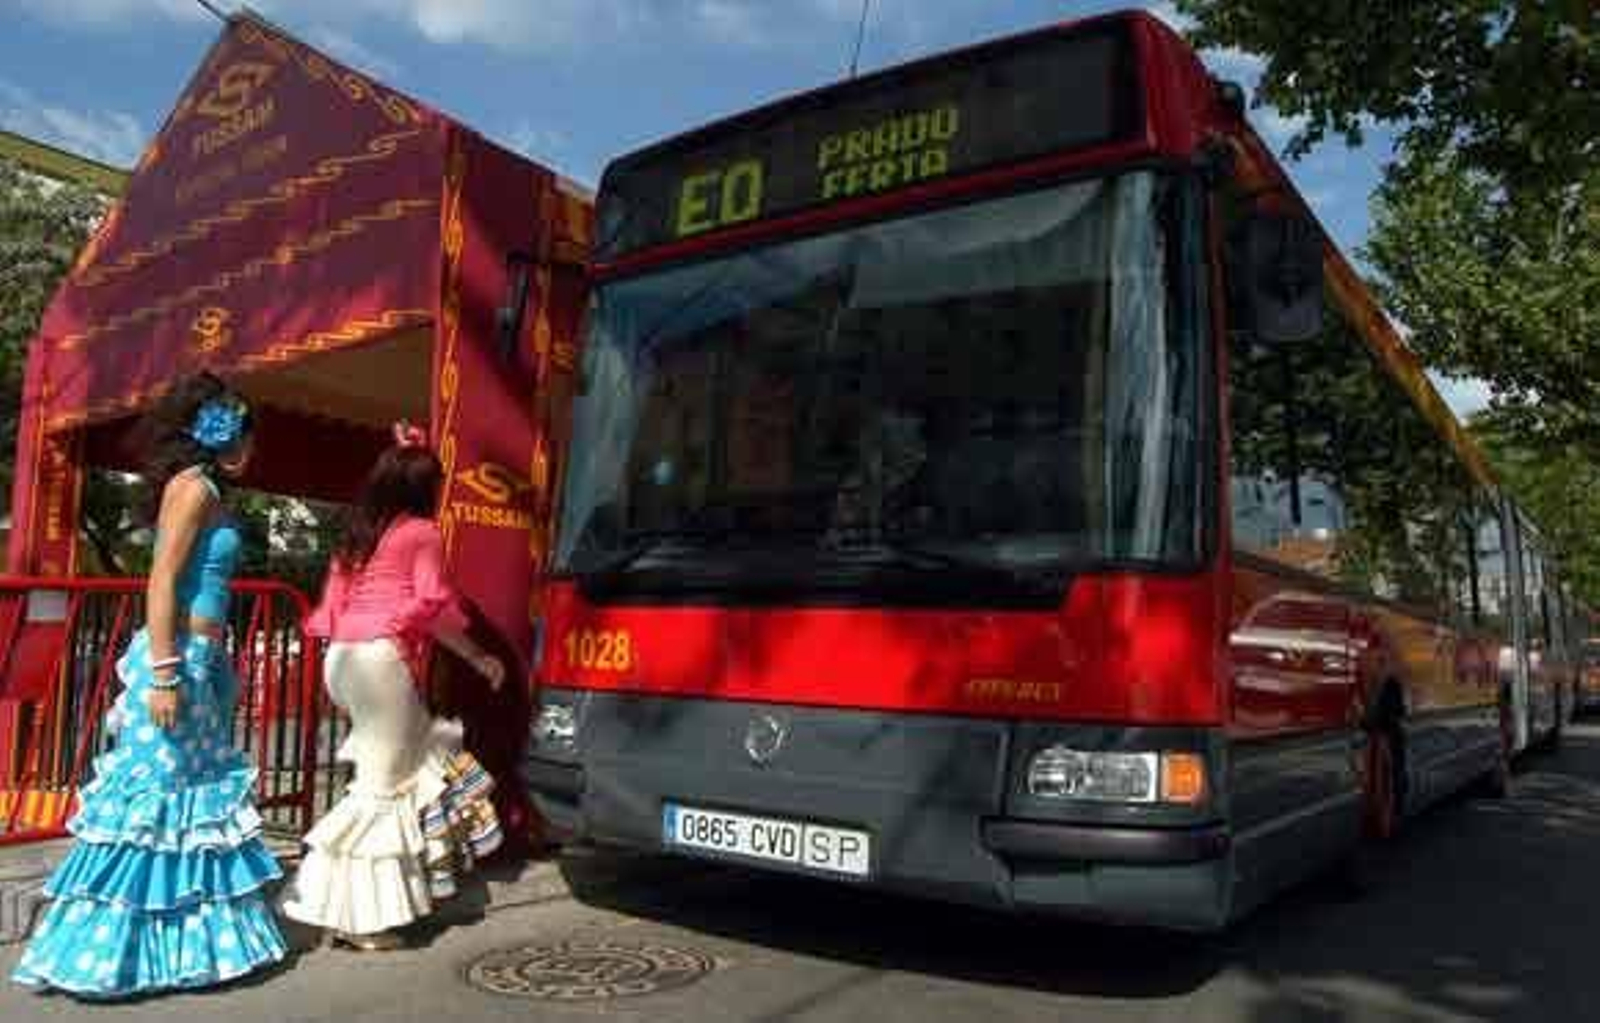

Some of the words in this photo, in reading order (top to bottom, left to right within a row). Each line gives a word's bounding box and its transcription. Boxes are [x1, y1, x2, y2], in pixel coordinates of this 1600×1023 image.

[817, 107, 958, 170] PRADO
[564, 628, 632, 673] 1028
[682, 813, 738, 847] 0865
[751, 822, 797, 858] CVD
